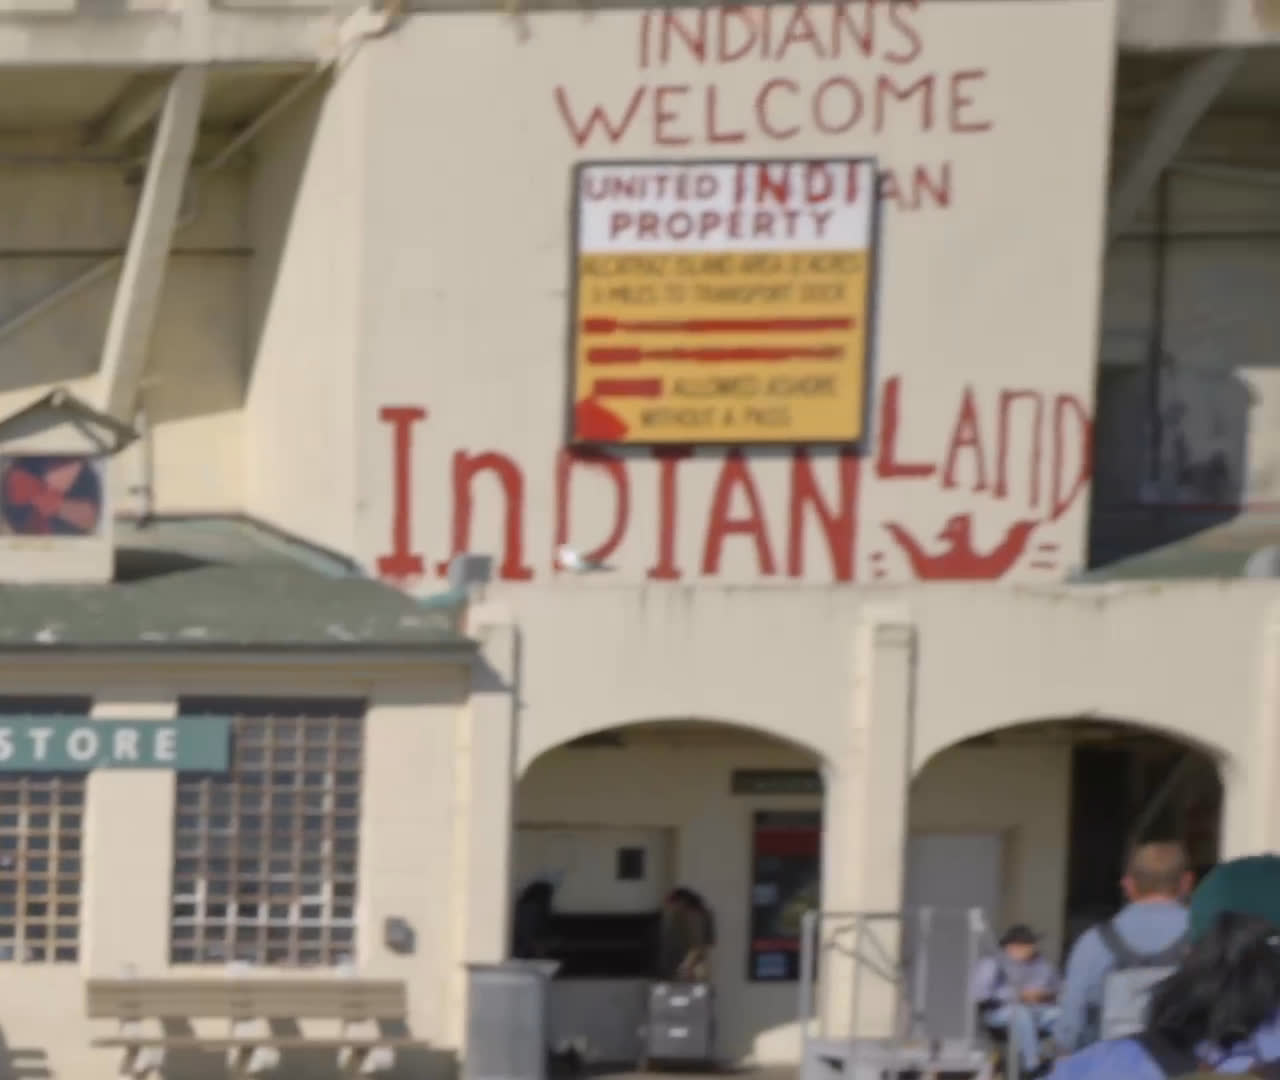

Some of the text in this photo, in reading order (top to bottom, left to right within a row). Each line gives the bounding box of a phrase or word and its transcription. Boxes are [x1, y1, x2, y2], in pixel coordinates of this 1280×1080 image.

[639, 0, 922, 68] INDIANS
[554, 69, 993, 148] WELCOME
[584, 173, 719, 201] UNITED
[609, 209, 834, 240] PROPERTY
